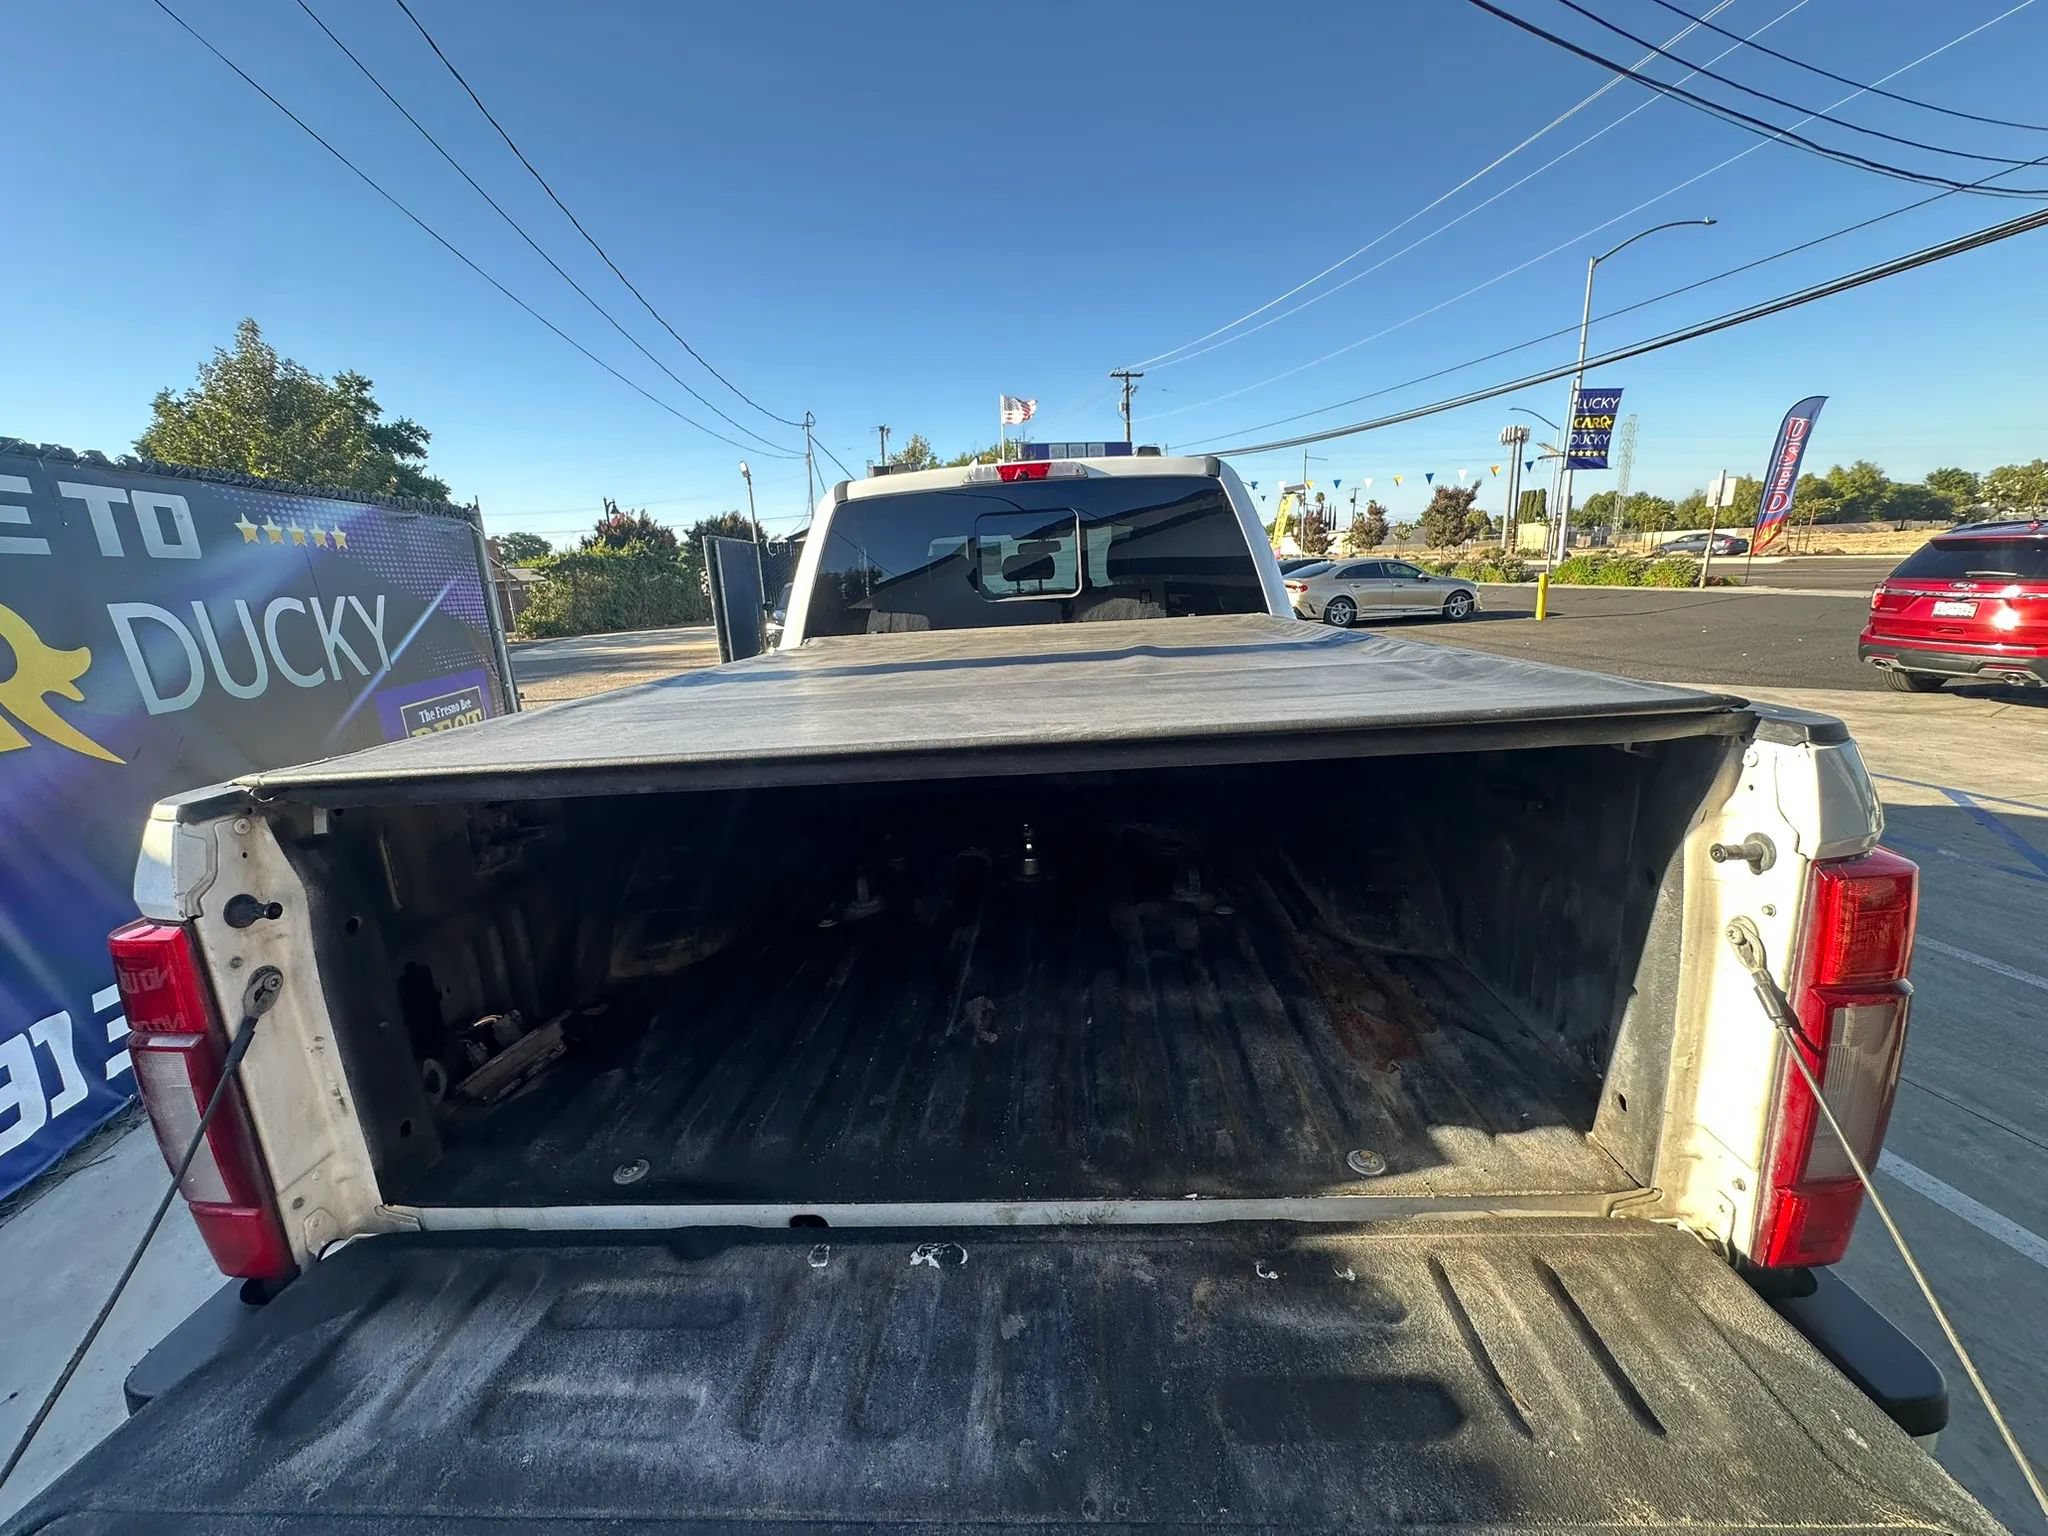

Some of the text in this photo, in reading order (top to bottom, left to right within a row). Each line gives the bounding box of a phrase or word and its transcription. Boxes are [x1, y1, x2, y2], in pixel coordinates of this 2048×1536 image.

[1577, 397, 1620, 409] LUCKY
[1570, 433, 1610, 445] DUCKY
[57, 480, 202, 560] TO
[106, 594, 393, 716] DUCKY
[419, 708, 436, 724] The
[435, 702, 460, 719] Fresno
[459, 698, 473, 711] Bee
